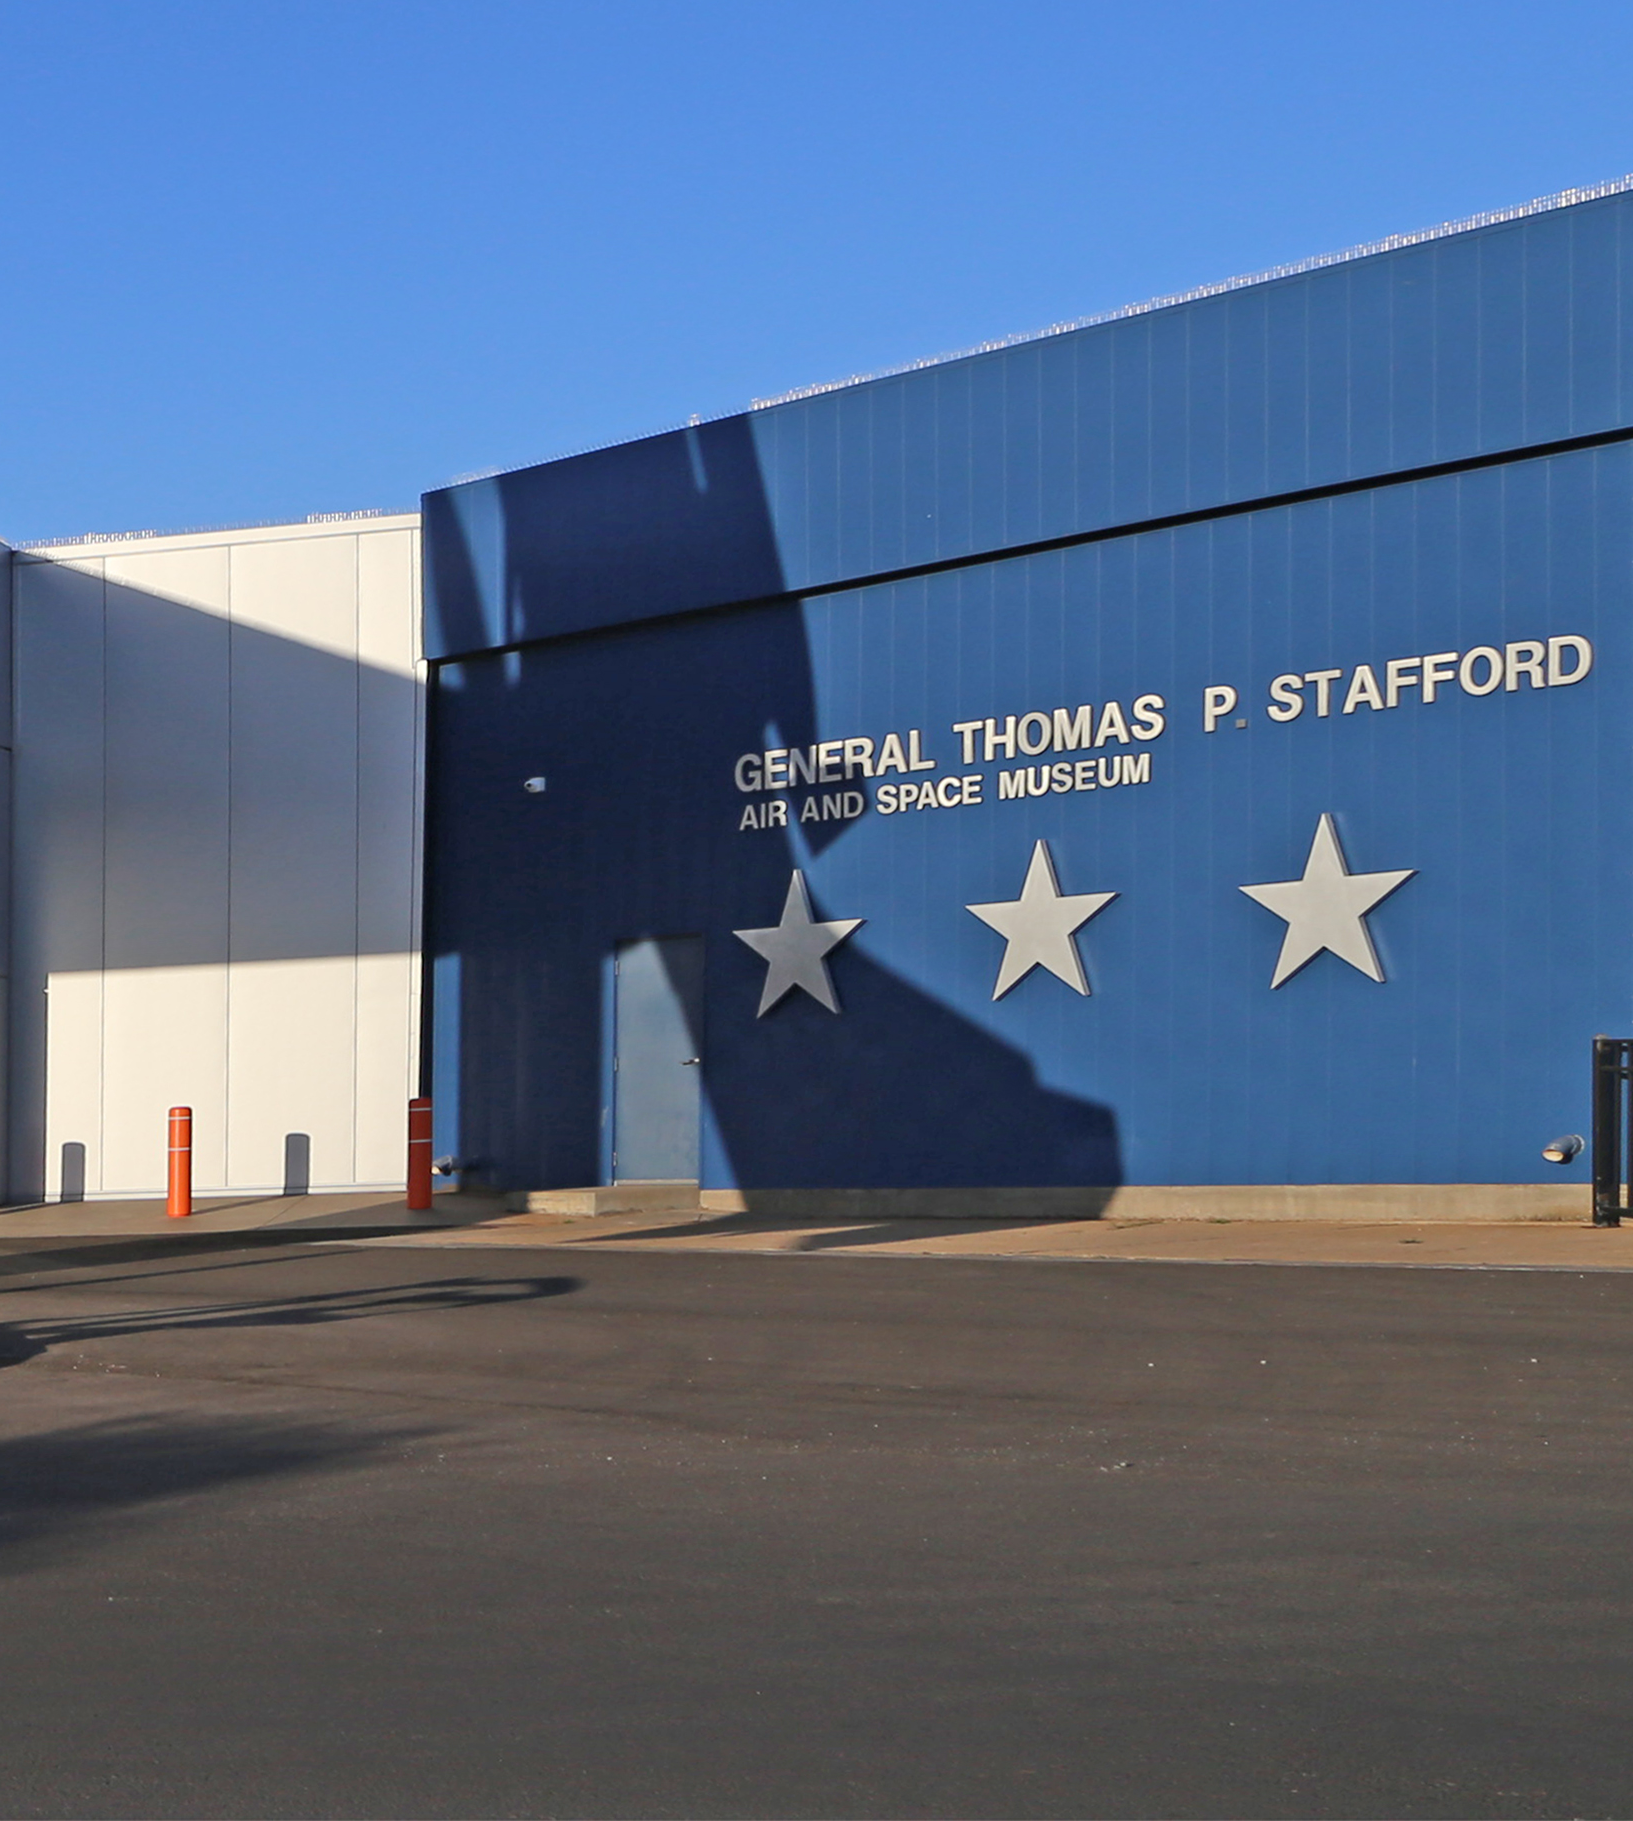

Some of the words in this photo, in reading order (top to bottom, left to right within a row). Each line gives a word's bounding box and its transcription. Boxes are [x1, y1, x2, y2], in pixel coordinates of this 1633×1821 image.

[734, 729, 936, 793] GENERAL
[952, 693, 1166, 766] THOMAS
[1202, 684, 1248, 734] P.
[1266, 634, 1594, 724] STAFFORD
[739, 799, 788, 830] AIR
[800, 790, 865, 824] AND
[875, 774, 984, 815] SPACE
[998, 752, 1152, 801] MUSEUM
